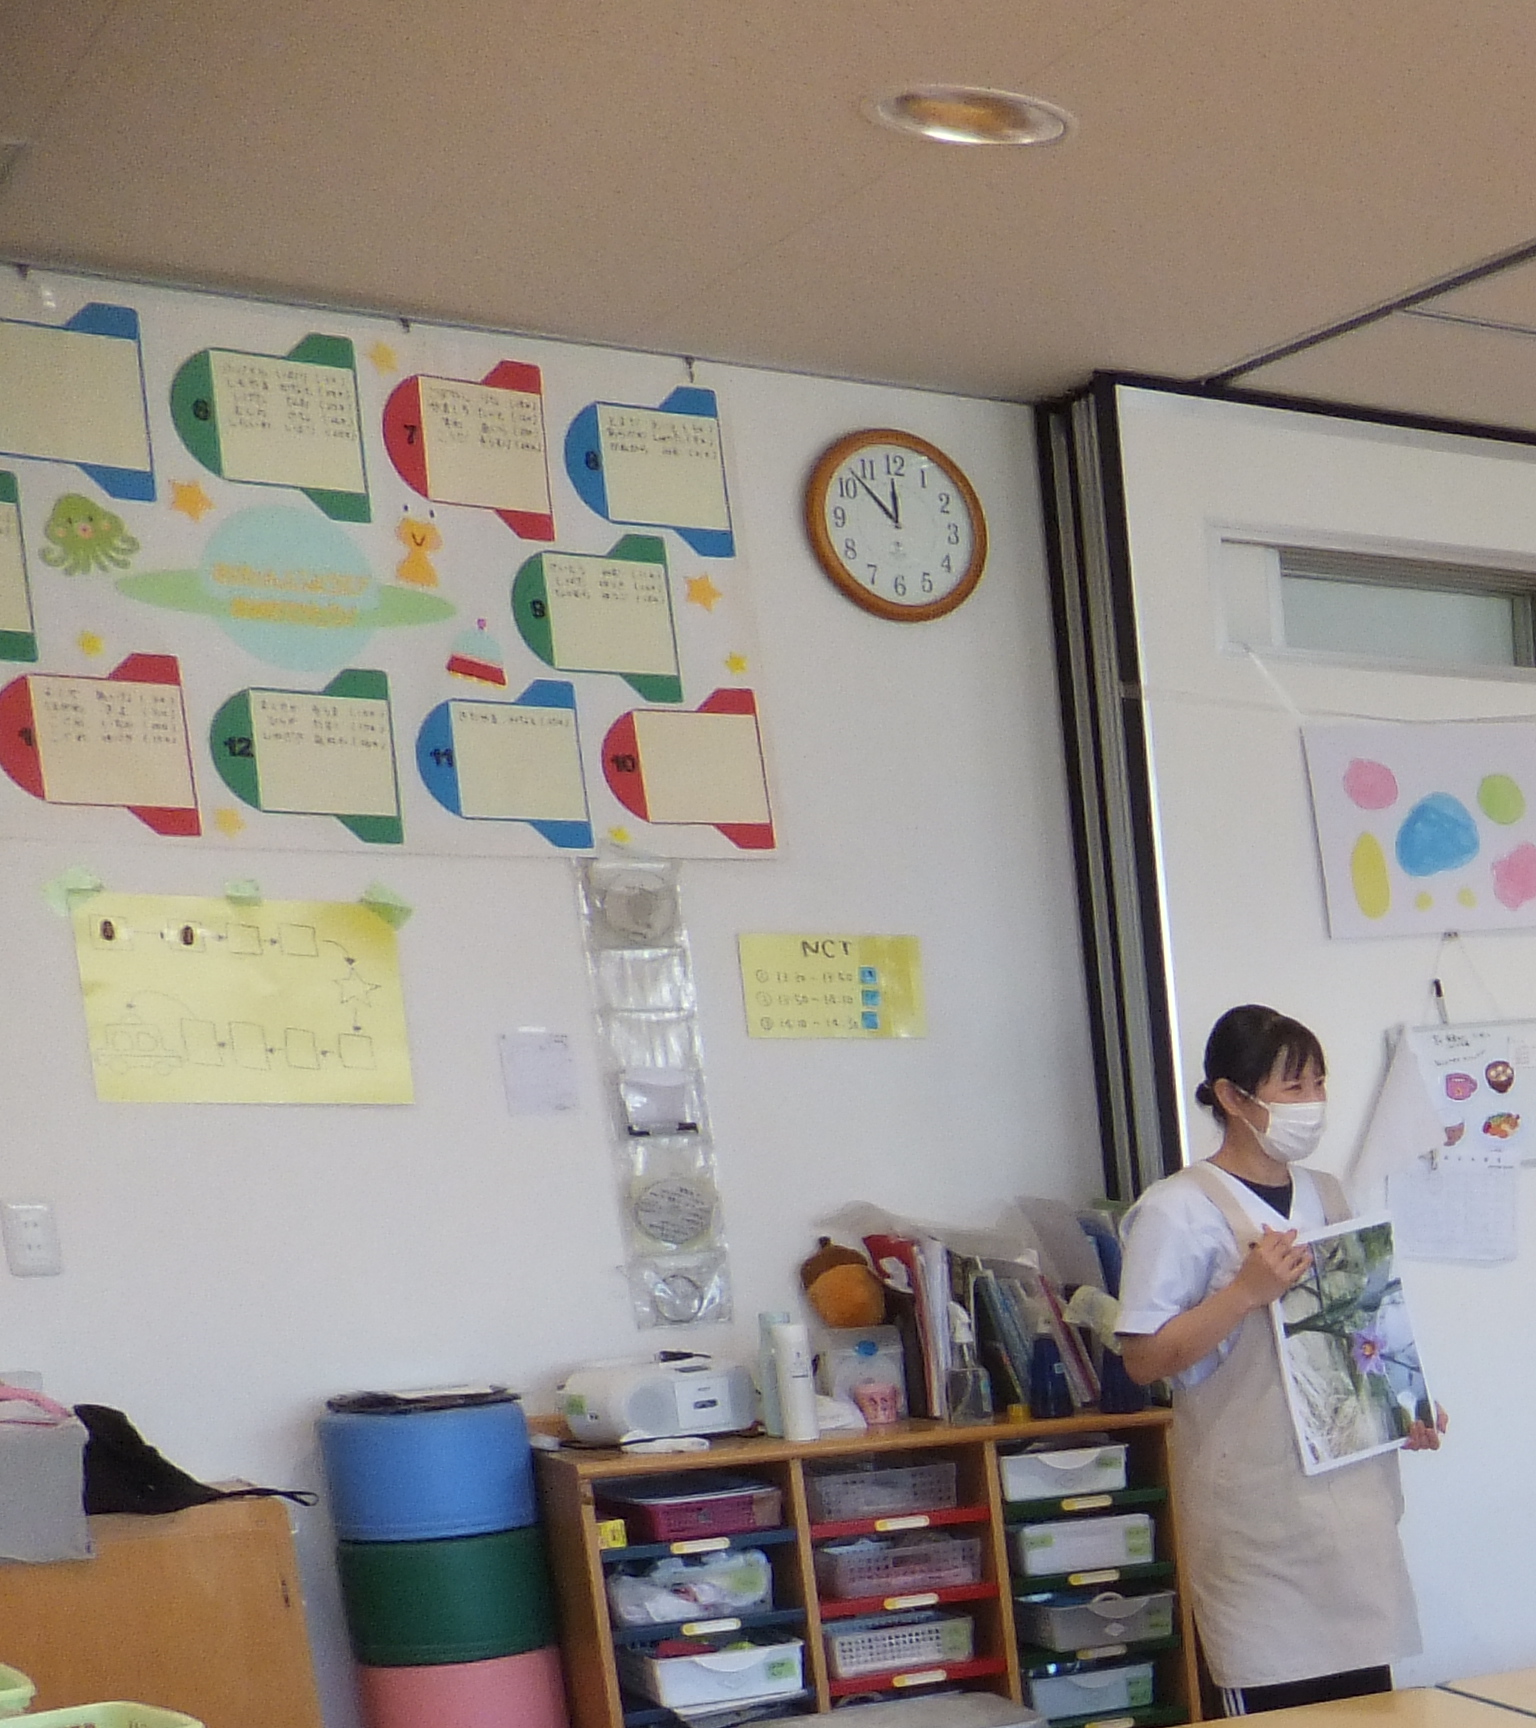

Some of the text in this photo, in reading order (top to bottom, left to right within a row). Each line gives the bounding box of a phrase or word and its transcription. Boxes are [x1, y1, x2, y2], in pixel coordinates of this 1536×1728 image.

[403, 424, 418, 445] 7
[859, 458, 876, 481] 11
[884, 454, 905, 477] 12
[838, 476, 858, 500] 10
[920, 469, 927, 488] 1
[937, 492, 951, 515] 2
[832, 505, 847, 528] 9
[946, 523, 961, 546] 3
[844, 537, 858, 560] 8
[866, 563, 879, 586] 7
[940, 552, 952, 574] 4
[893, 574, 907, 597] 6
[920, 571, 934, 594] 5
[223, 736, 255, 758] 12
[429, 747, 455, 768] 11
[611, 753, 636, 773] 10
[801, 938, 853, 959] NCT
